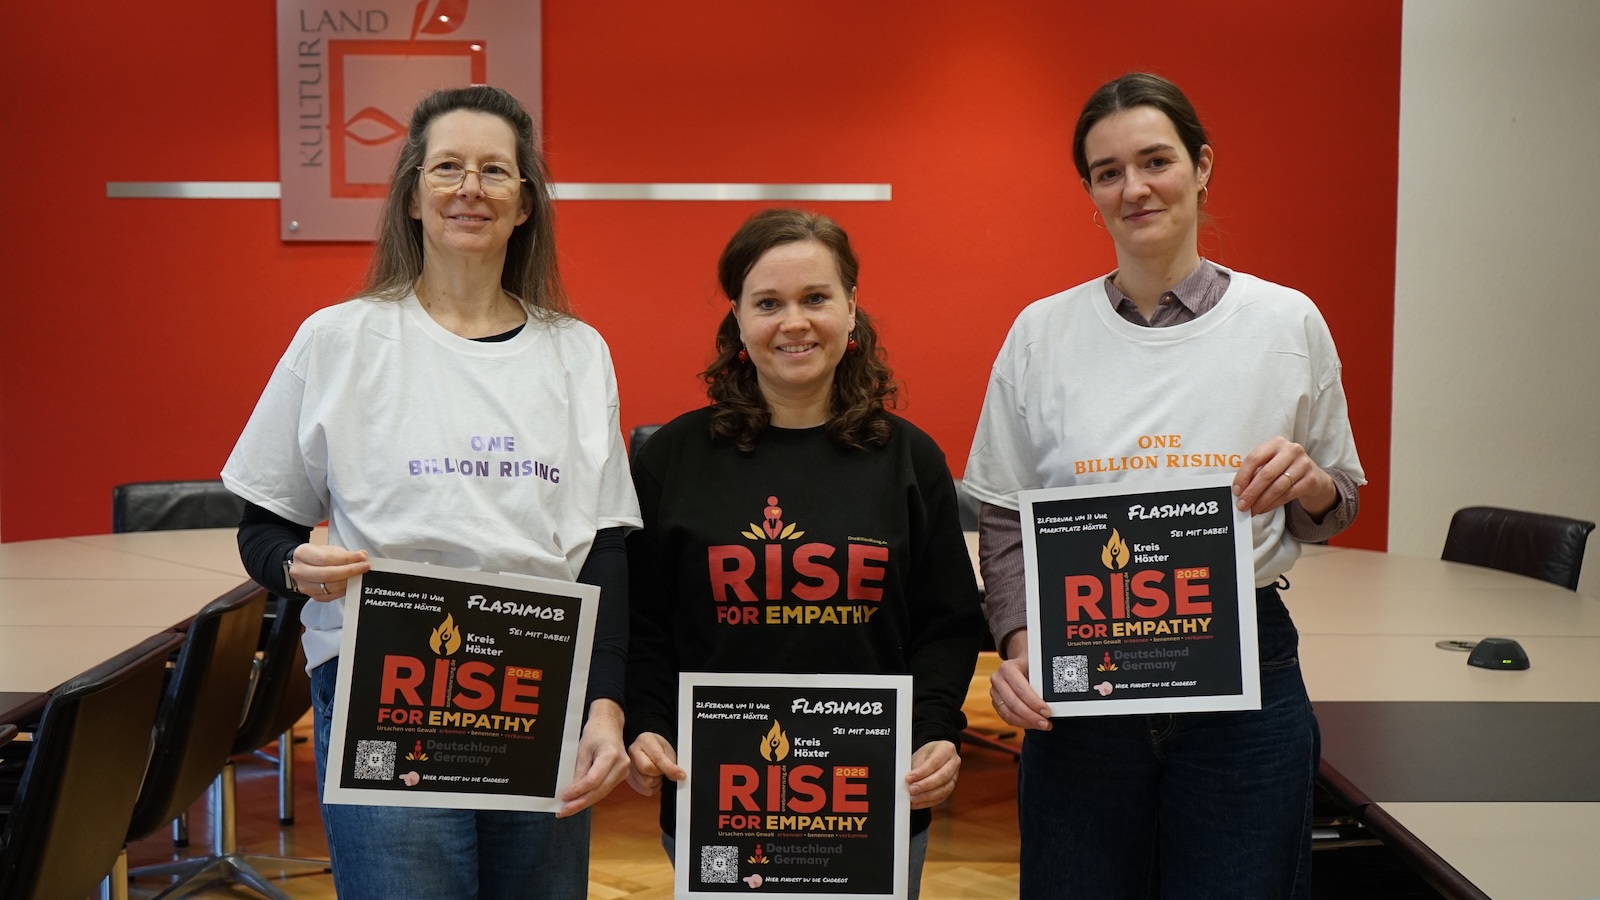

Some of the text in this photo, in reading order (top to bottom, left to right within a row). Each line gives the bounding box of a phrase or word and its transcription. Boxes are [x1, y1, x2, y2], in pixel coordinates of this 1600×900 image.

[300, 9, 388, 33] LAND
[298, 38, 322, 167] KULTUR
[471, 436, 515, 451] ONE
[1138, 435, 1182, 449] ONE
[408, 458, 560, 483] BILLION RISING
[1074, 454, 1242, 474] BILLION RISING
[1134, 543, 1160, 552] Kreis
[1134, 554, 1169, 563] Höxter
[708, 542, 889, 602] RISE
[1177, 569, 1207, 579] 2026
[1065, 567, 1213, 621] RISE
[716, 605, 879, 625] FOR EMPATHY
[1067, 618, 1212, 639] FOR EMPATHY
[467, 633, 495, 644] Kreis
[466, 644, 503, 656] Höxter
[1114, 647, 1189, 660] Deutschland
[1122, 658, 1177, 671] Germany
[507, 668, 540, 679] 2026
[379, 654, 543, 715] RISE
[378, 708, 537, 732] FOR EMPATHY
[426, 740, 507, 754] Deutschland
[794, 738, 821, 746] Kreis
[433, 751, 492, 766] Germany
[794, 749, 829, 758] Höxter
[836, 768, 866, 776] 2026
[718, 764, 869, 813] RISE
[718, 814, 868, 831] FOR EMPATHY
[766, 843, 842, 854] Deutschland
[774, 855, 830, 867] Germany
